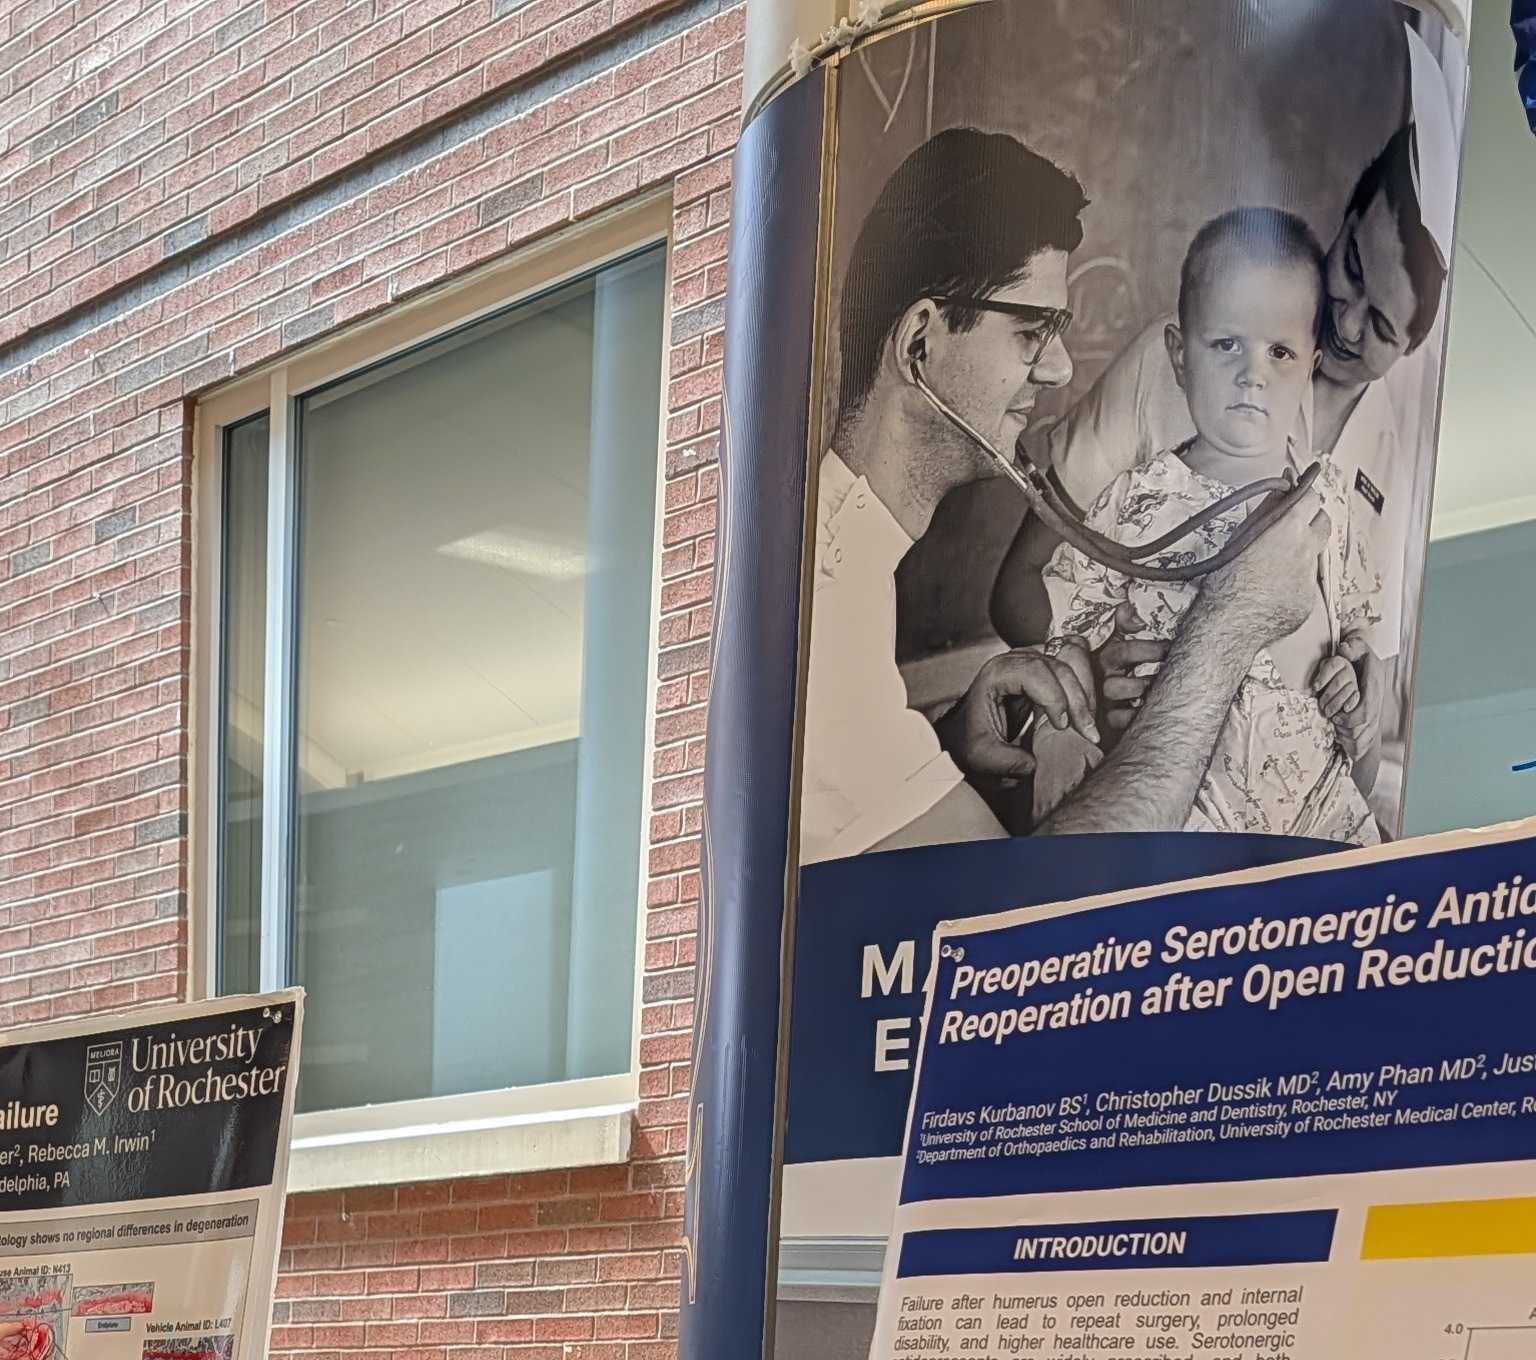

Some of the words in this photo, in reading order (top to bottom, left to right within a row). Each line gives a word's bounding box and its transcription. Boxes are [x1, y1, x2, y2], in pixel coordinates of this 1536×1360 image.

[949, 936, 1152, 1000] Preoperative
[1160, 894, 1419, 950] Serotonergic
[938, 987, 1132, 1045] Reoperation
[1140, 972, 1234, 1016] after
[1242, 962, 1345, 1010] Open
[132, 1024, 263, 1072] University
[128, 1074, 157, 1113] of
[157, 1065, 285, 1110] Rochester
[921, 1108, 976, 1134] Firdavs
[978, 1102, 1057, 1124] Kurbanov
[1095, 1084, 1205, 1113] Christopher
[1207, 1076, 1273, 1103] Dussik
[1325, 1070, 1375, 1094] Amy
[1378, 1063, 1434, 1087] Phan
[979, 1126, 995, 1142] of
[994, 1122, 1058, 1140] Rochester
[1058, 1114, 1104, 1134] School
[1105, 1113, 1123, 1130] of
[1123, 1106, 1188, 1128] Medicine
[1189, 1105, 1219, 1123] and
[1220, 1102, 1287, 1121] Dentistry,
[1291, 1092, 1369, 1114] Rochester,
[1372, 1089, 1399, 1107] NY
[987, 1141, 1003, 1158] of
[1003, 1135, 1087, 1157] Orthopaedics
[1089, 1132, 1117, 1150] and
[1118, 1126, 1216, 1147] Rehabilitation,
[1219, 1115, 1292, 1140] University
[1294, 1115, 1313, 1134] of
[1312, 1108, 1392, 1132] Rochester
[1394, 1103, 1459, 1125] Medical
[1461, 1100, 1517, 1119] Center,
[27, 1138, 92, 1164] Rebecca
[93, 1130, 115, 1156] M.
[53, 1170, 71, 1189] PA
[30, 1232, 61, 1245] shows
[62, 1231, 75, 1242] no
[76, 1225, 116, 1244] regional
[116, 1223, 172, 1238] differences
[173, 1219, 184, 1233] in
[185, 1214, 249, 1234] degeneration
[1013, 1231, 1187, 1260] INTRODUCTION
[897, 1315, 943, 1332] fixation
[954, 1317, 983, 1331] can
[995, 1313, 1030, 1330] lead
[1041, 1313, 1057, 1330] to
[1070, 1312, 1122, 1332] repeat
[1135, 1314, 1201, 1333] surgery,
[1216, 1307, 1300, 1332] prolonged
[900, 1295, 945, 1313] Failure
[950, 1293, 986, 1311] after
[992, 1293, 1058, 1310] humerus
[1066, 1294, 1105, 1312] open
[1113, 1289, 1191, 1308] reduction
[1200, 1288, 1234, 1307] and
[1240, 1285, 1304, 1305] internal
